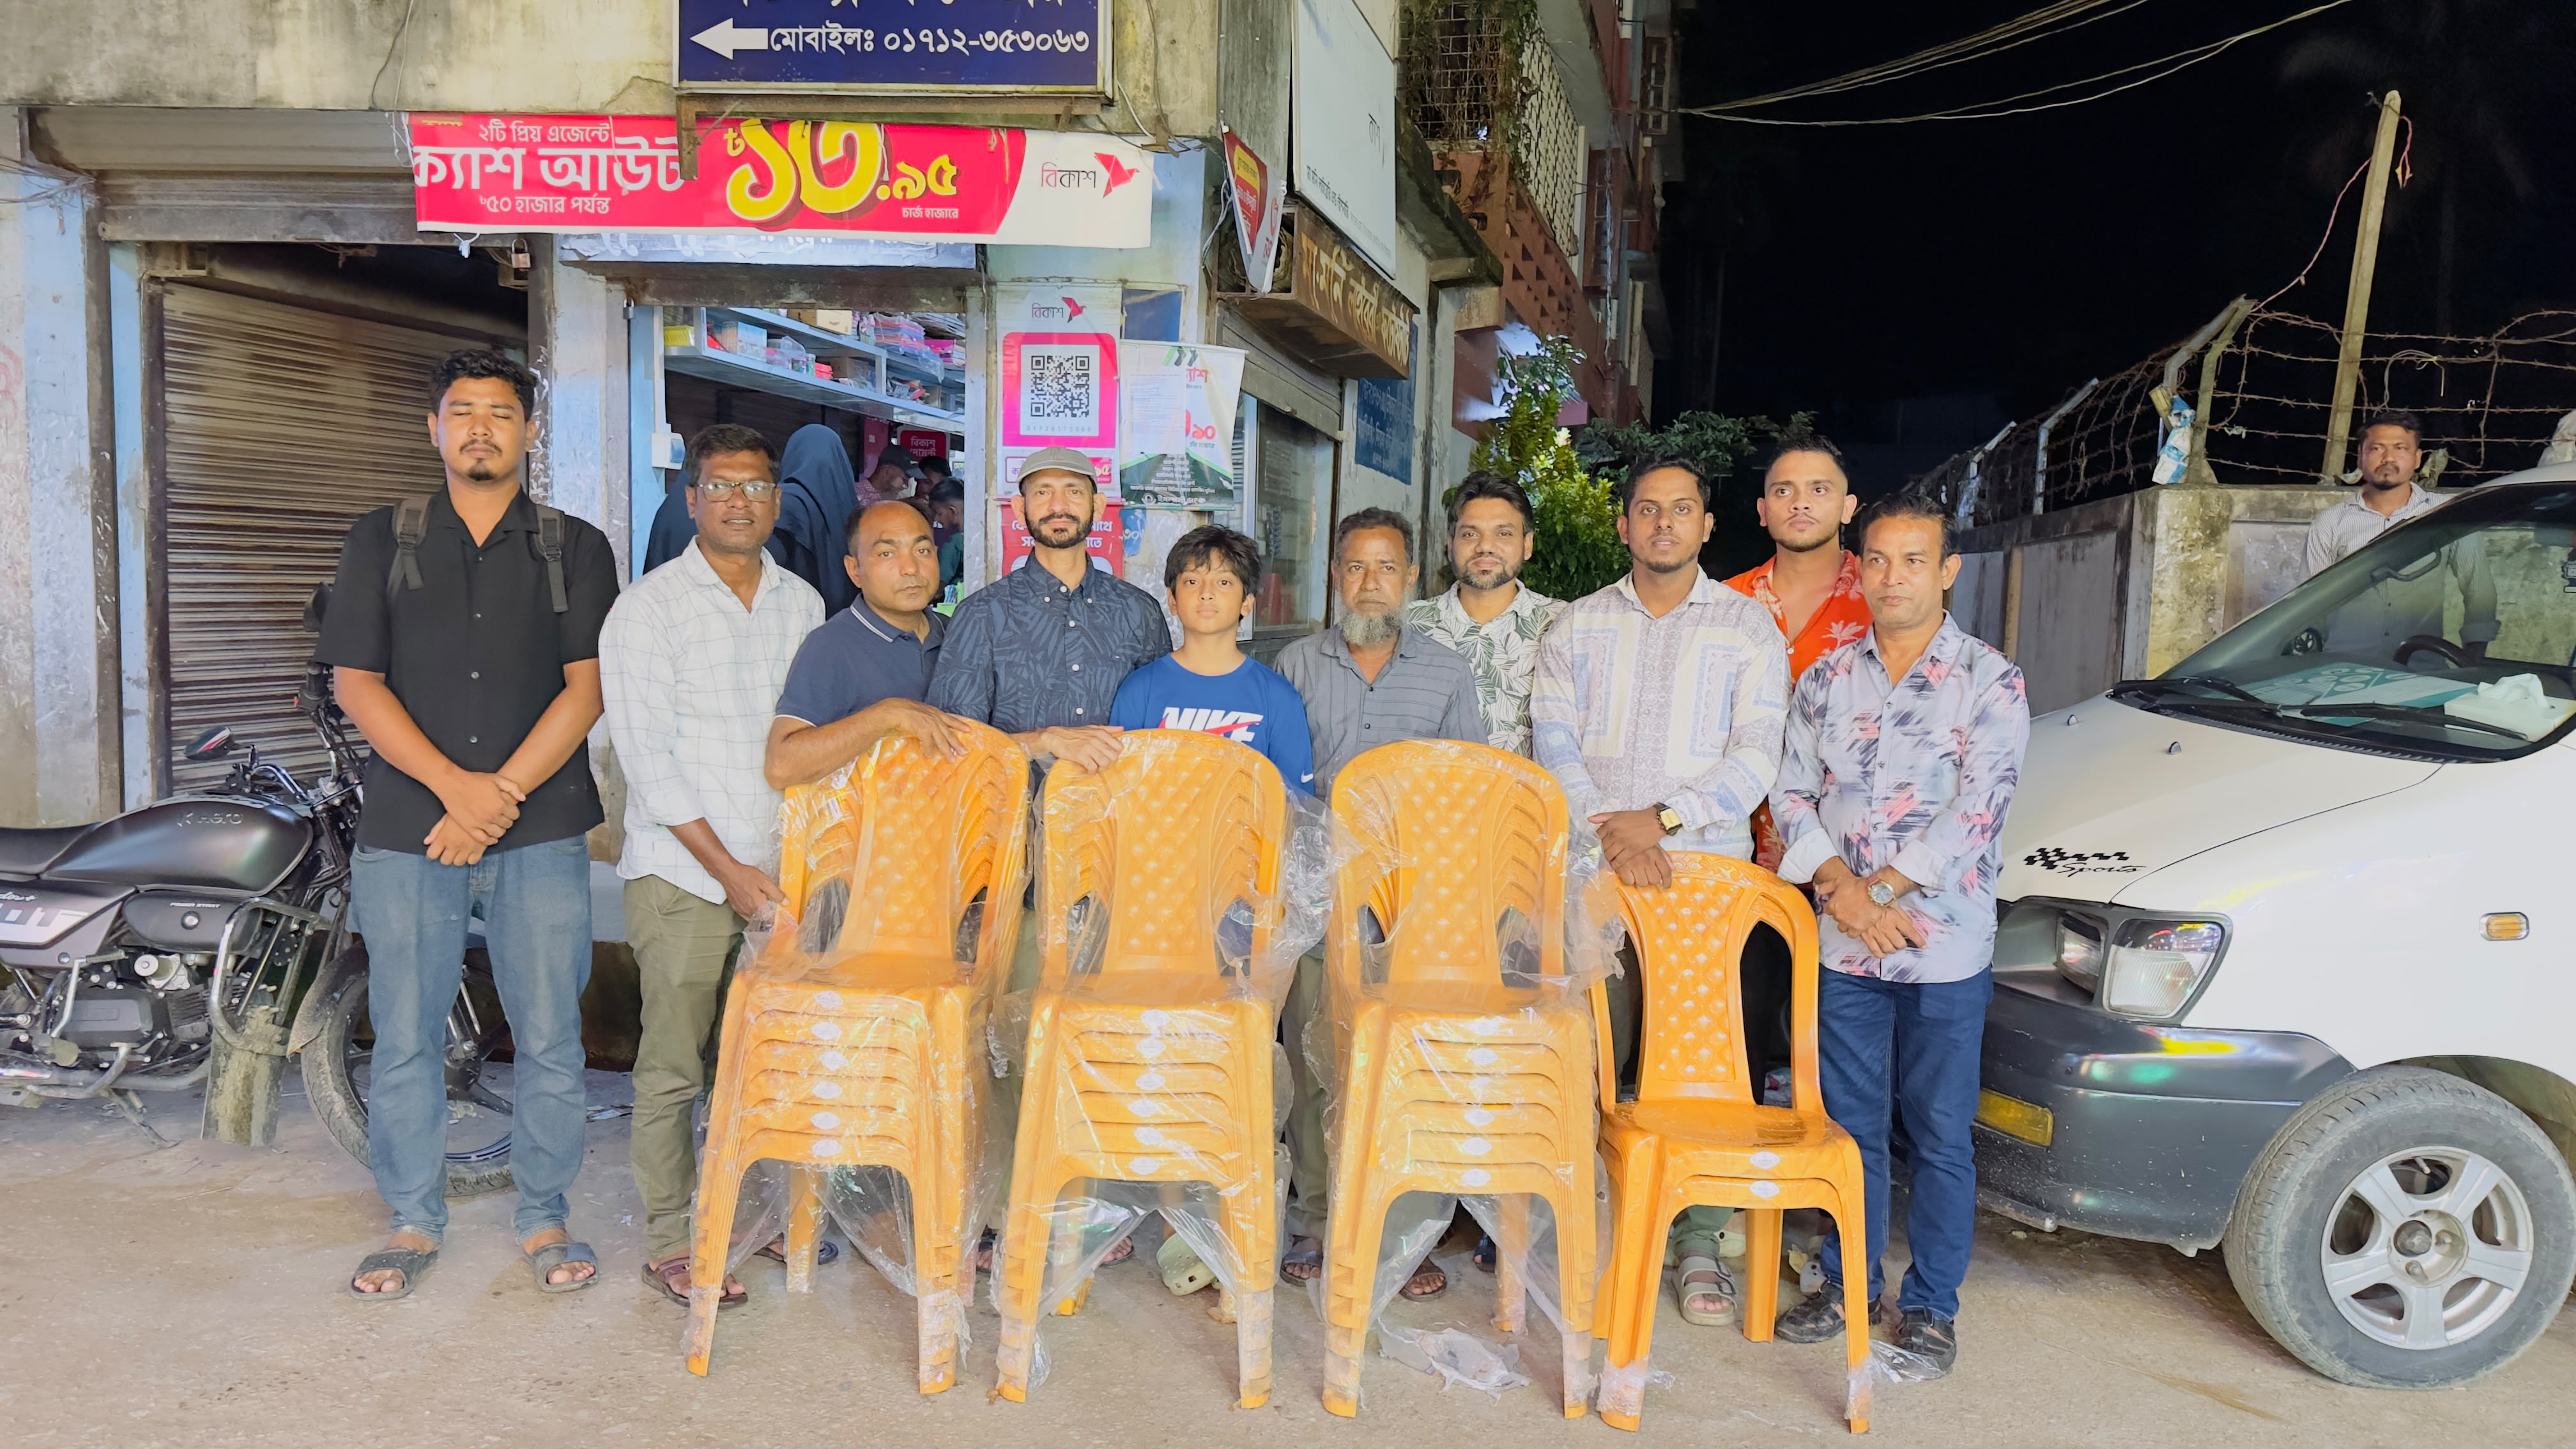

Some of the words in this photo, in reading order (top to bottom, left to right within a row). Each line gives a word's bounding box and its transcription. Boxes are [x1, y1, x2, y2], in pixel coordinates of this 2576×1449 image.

[770, 20, 874, 55] মোবাইলঃ
[884, 28, 1089, 56] ০১৭১২-৩৫৩০৬৩
[479, 119, 507, 142] ২টি
[509, 120, 542, 142] প্রিয়
[547, 123, 610, 142] এজেন্টে
[413, 146, 526, 190] ক্যাশ
[537, 135, 685, 192] আউট
[1041, 162, 1097, 190] বিকাশ
[514, 196, 567, 213] হাজার
[571, 193, 611, 214] পর্যন্ত
[924, 208, 959, 219] হাজারে
[1031, 302, 1064, 318] বিকাশ
[910, 436, 936, 448] বিকাশ
[1162, 707, 1264, 742] NIKE
[2057, 863, 2146, 877] Sports
